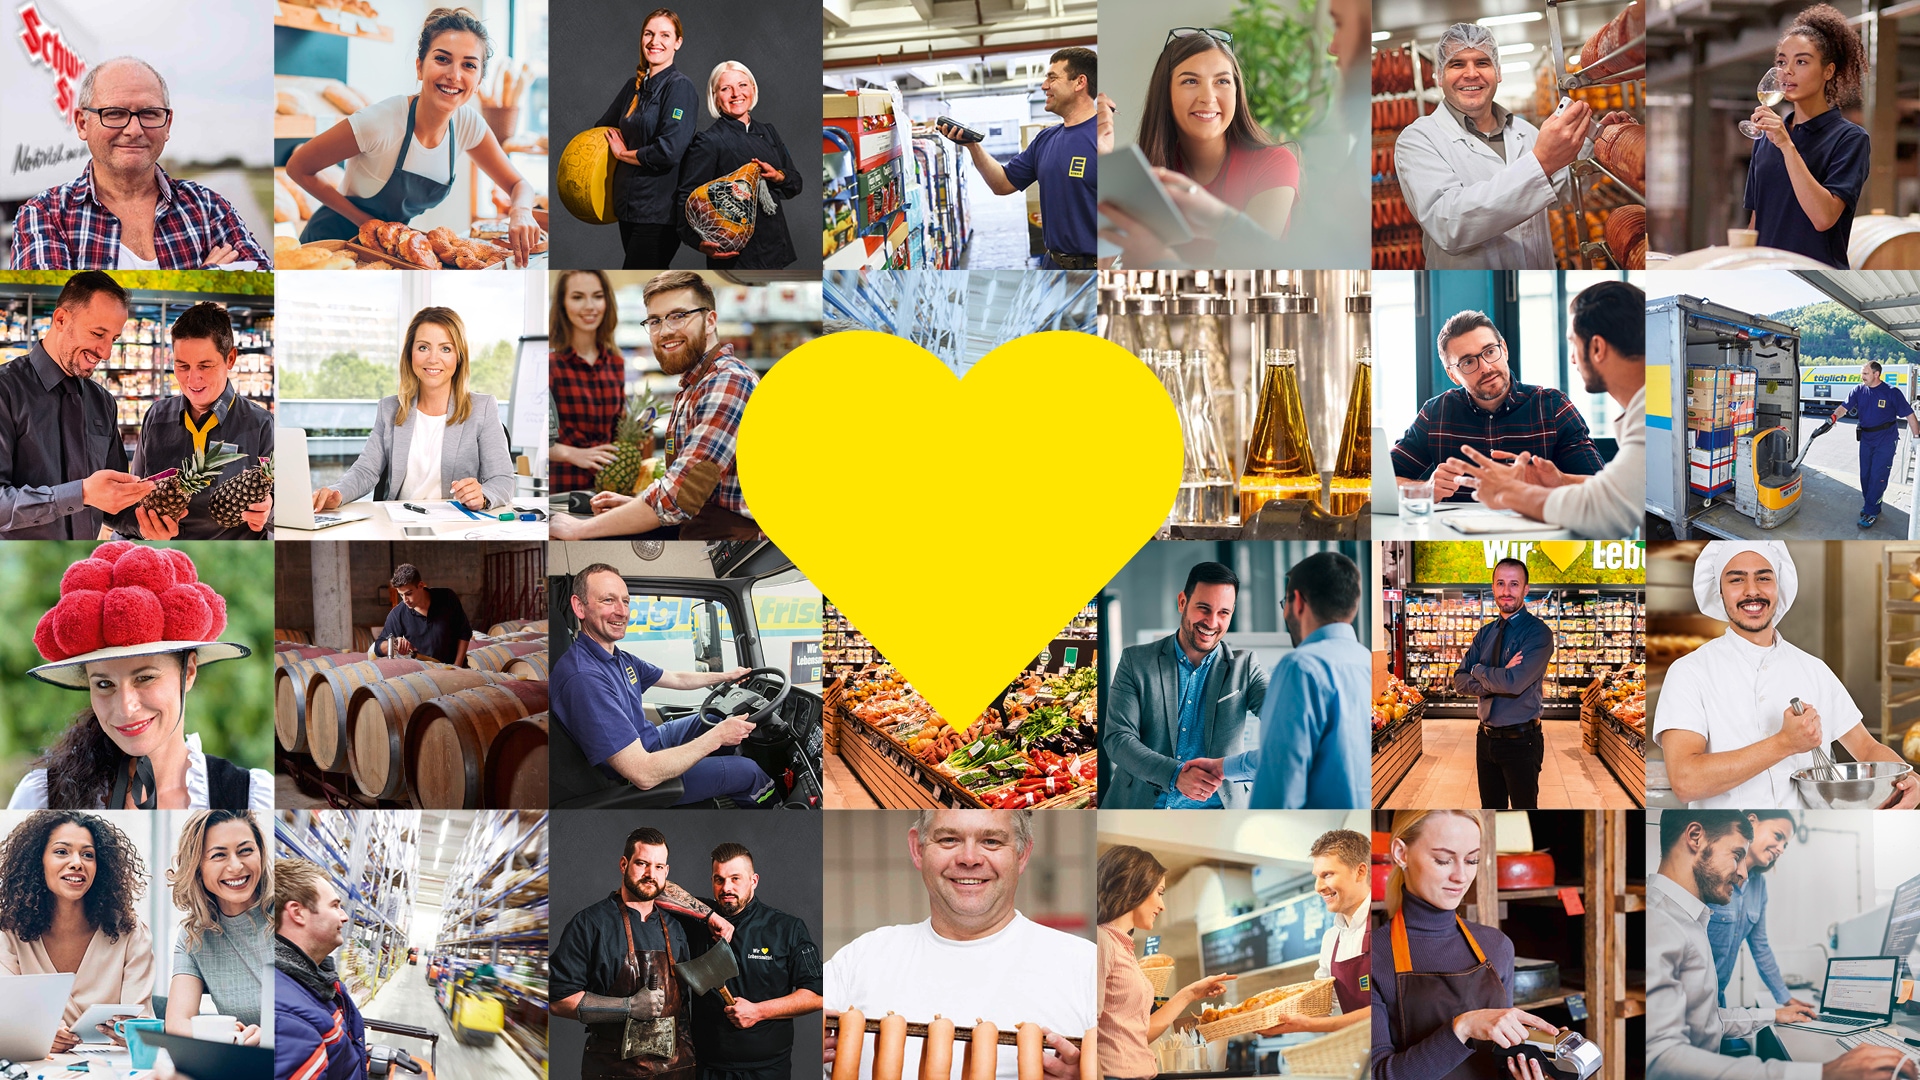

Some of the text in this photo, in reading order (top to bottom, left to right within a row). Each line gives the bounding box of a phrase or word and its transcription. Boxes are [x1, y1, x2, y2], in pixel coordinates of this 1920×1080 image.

[1814, 374, 1865, 385] täglich fri
[1783, 483, 1800, 497] STILL
[1483, 540, 1533, 569] Wir
[806, 643, 818, 654] Wir
